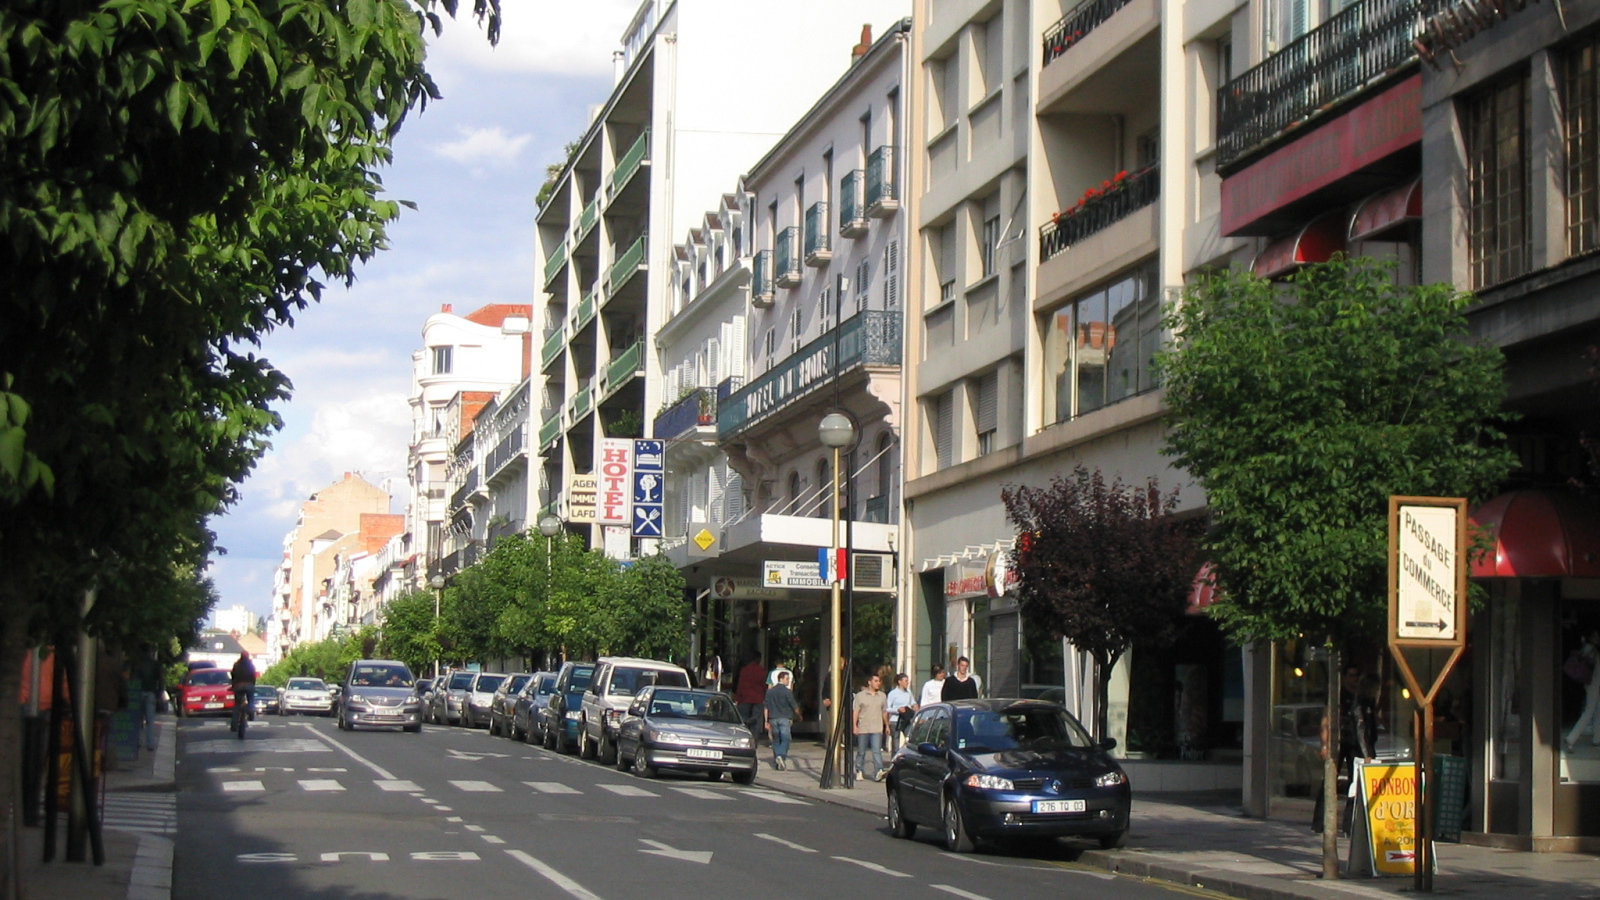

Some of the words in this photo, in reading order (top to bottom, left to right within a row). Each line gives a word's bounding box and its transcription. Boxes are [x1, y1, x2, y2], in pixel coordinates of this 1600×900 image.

[746, 381, 775, 419] HOTEL
[602, 448, 628, 520] HOTEL
[1405, 511, 1450, 570] PASSAGE
[1422, 552, 1432, 571] du
[1402, 551, 1452, 613] COMMERCE
[1040, 802, 1056, 812] 276
[1060, 802, 1069, 811] TQ
[1074, 801, 1084, 811] 03
[1384, 838, 1391, 846] A
